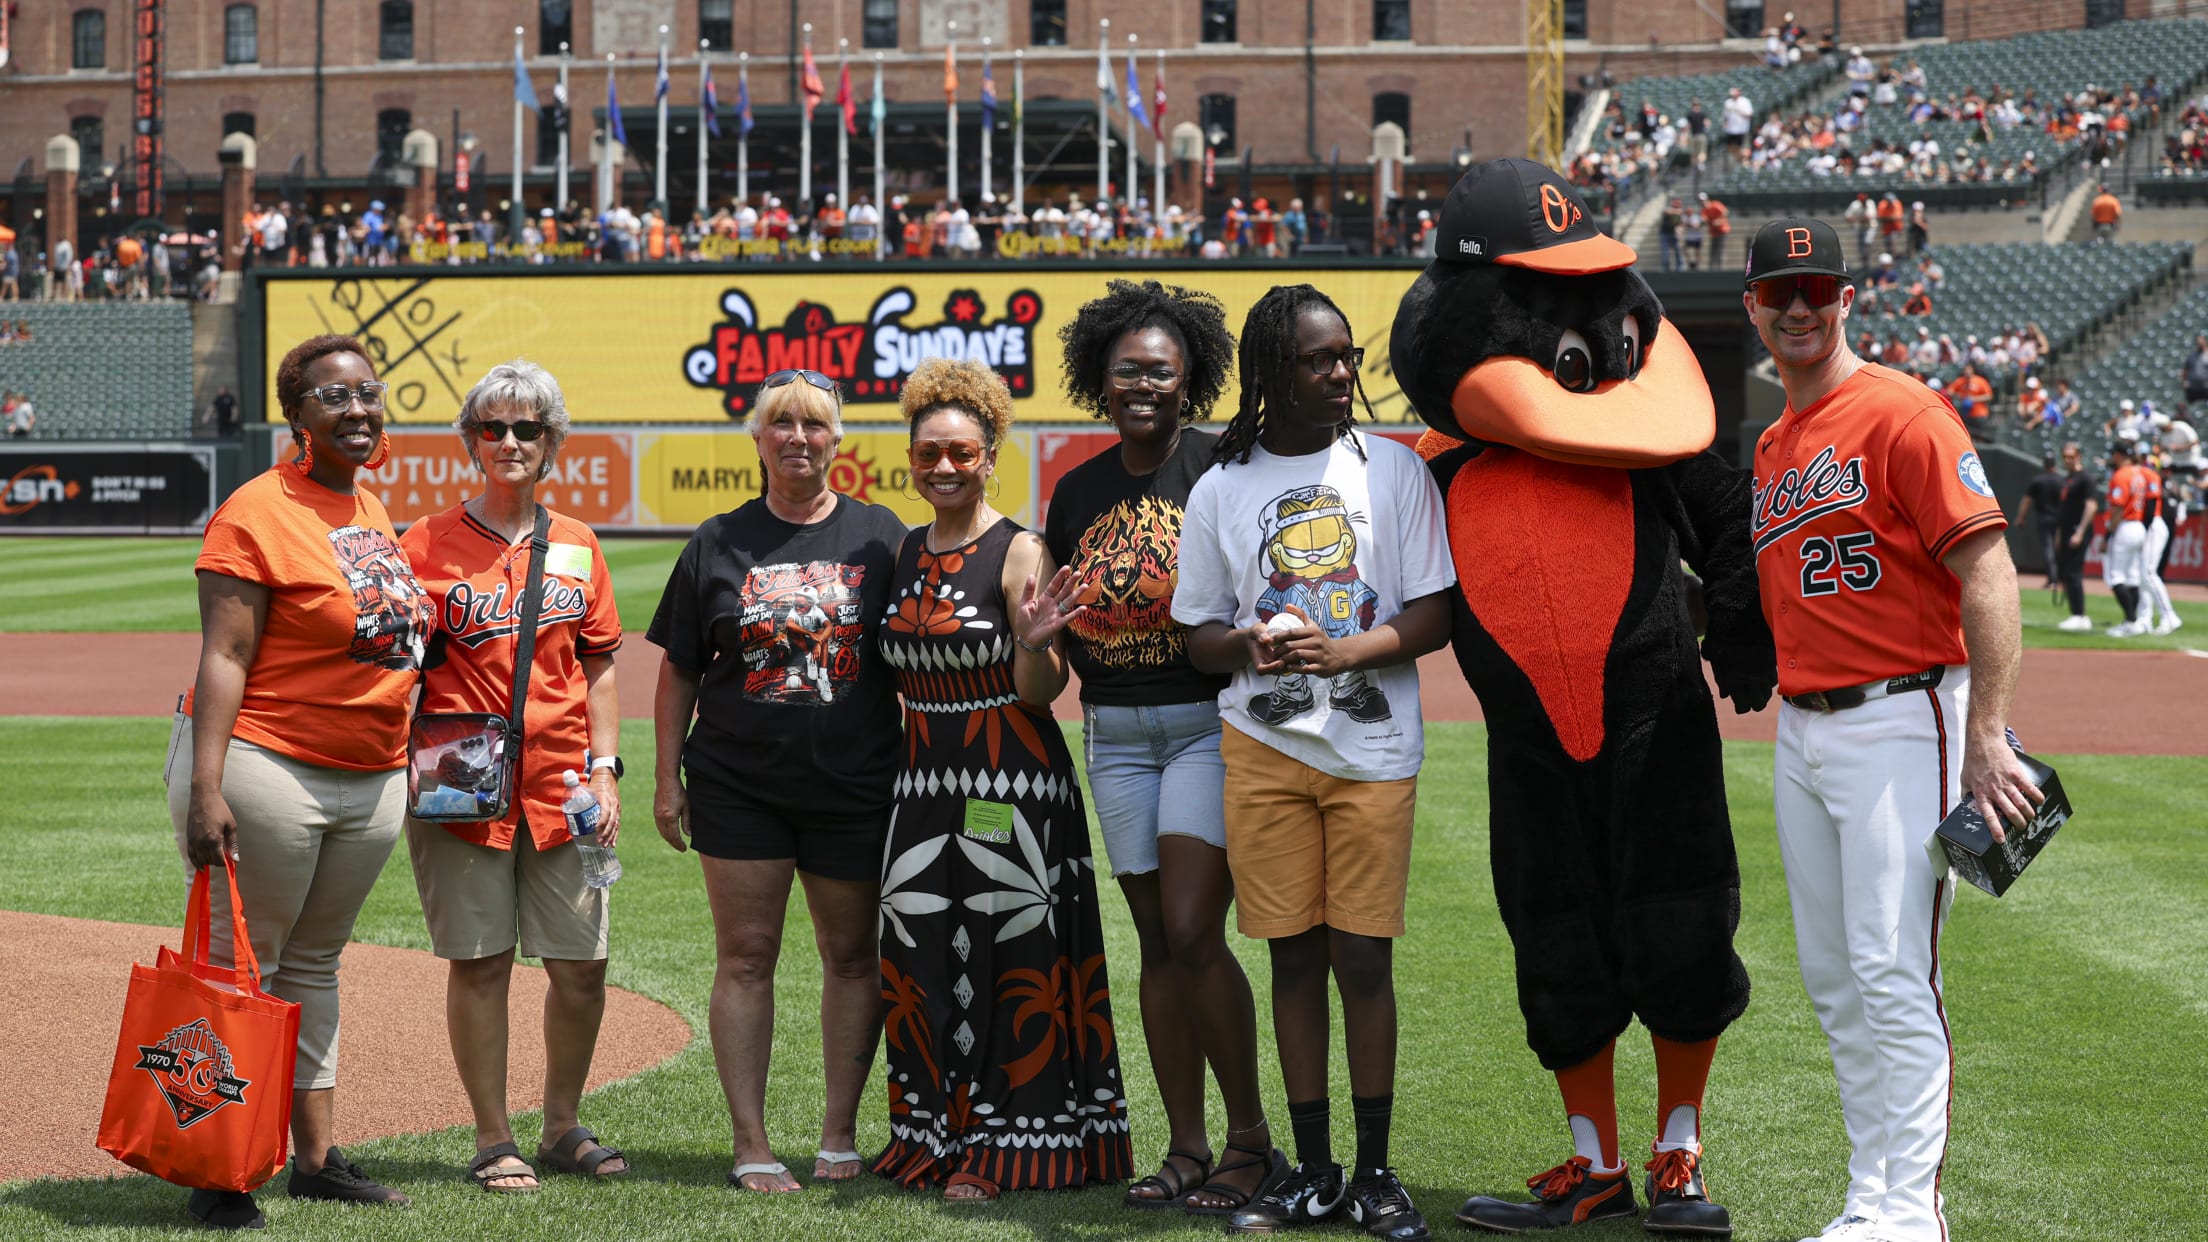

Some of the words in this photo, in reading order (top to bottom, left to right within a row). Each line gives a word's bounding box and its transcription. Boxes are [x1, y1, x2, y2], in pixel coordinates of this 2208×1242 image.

[1541, 184, 1583, 233] O's
[1458, 239, 1483, 255] fello.
[1785, 227, 1813, 258] B
[354, 456, 487, 485] AUTUM
[541, 456, 608, 485] AKE
[753, 560, 836, 594] Orioles
[1800, 531, 1882, 597] 25
[1330, 591, 1351, 620] G
[146, 1053, 171, 1067] 1970
[167, 1084, 213, 1108] ANNIVERSARY
